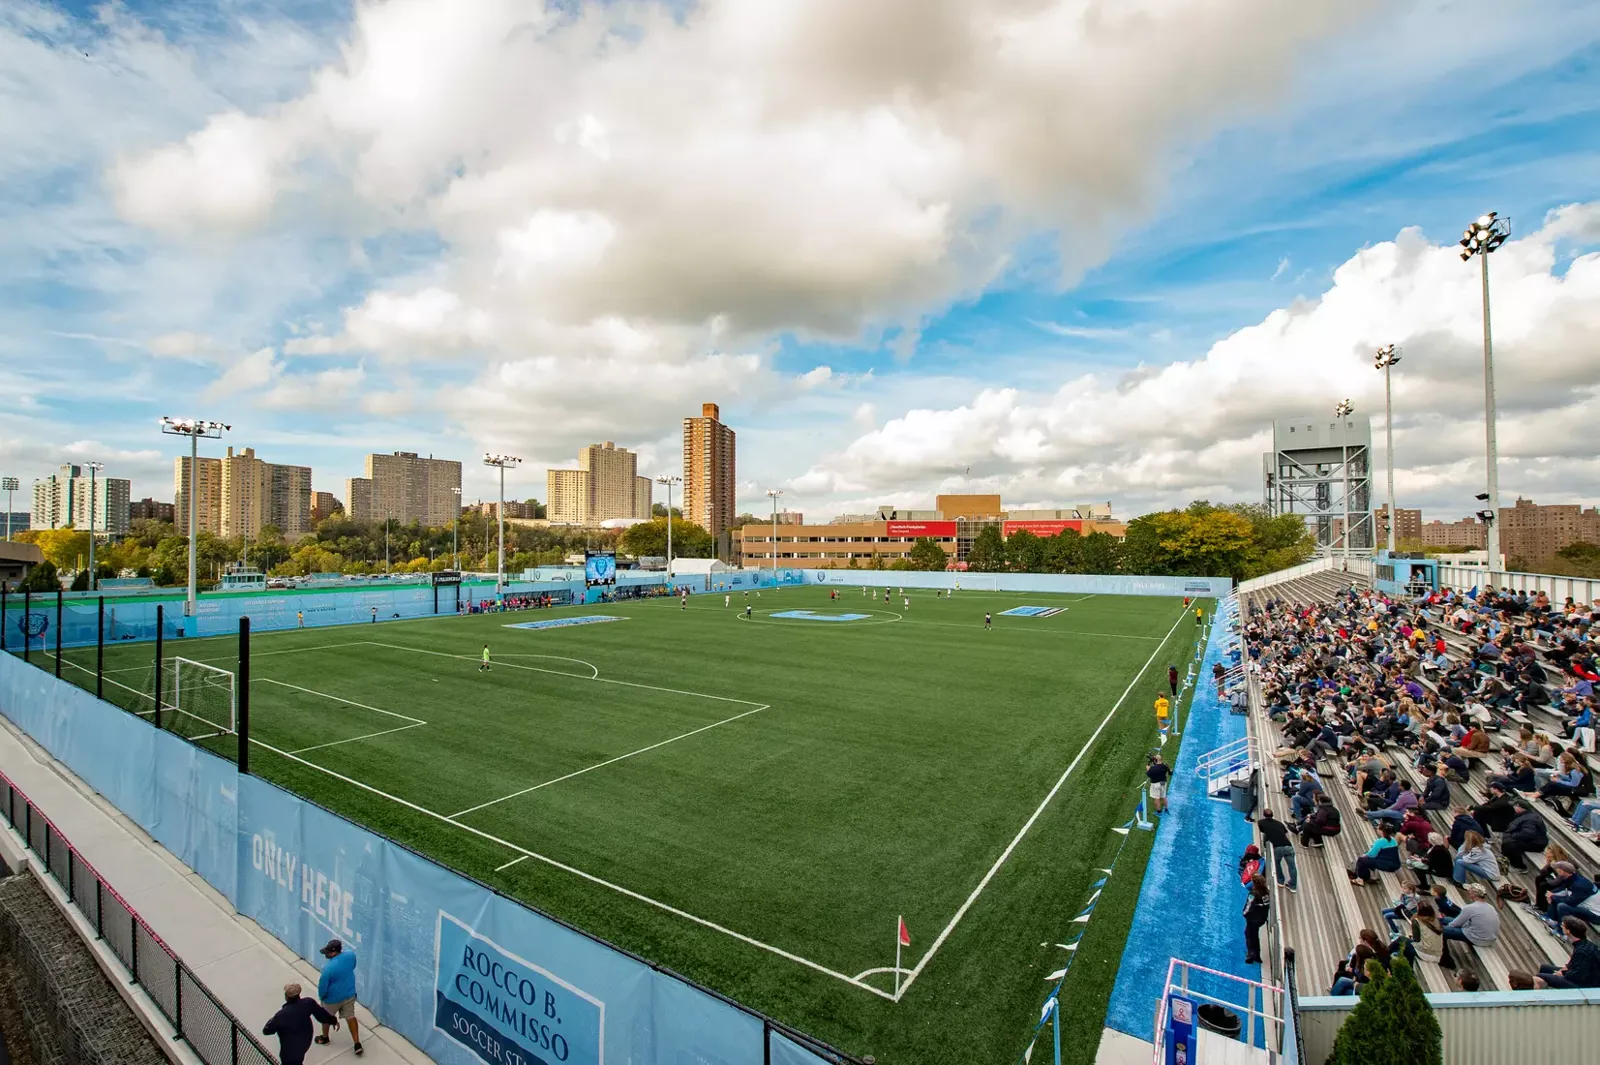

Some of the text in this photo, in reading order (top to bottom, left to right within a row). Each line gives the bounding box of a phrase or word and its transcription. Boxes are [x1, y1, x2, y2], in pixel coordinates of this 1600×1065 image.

[253, 833, 362, 944] ONLY HERE.
[455, 973, 569, 1062] COMMISSO
[462, 945, 562, 1024] ROCCO B.
[453, 1012, 527, 1065] SOCCER ST
